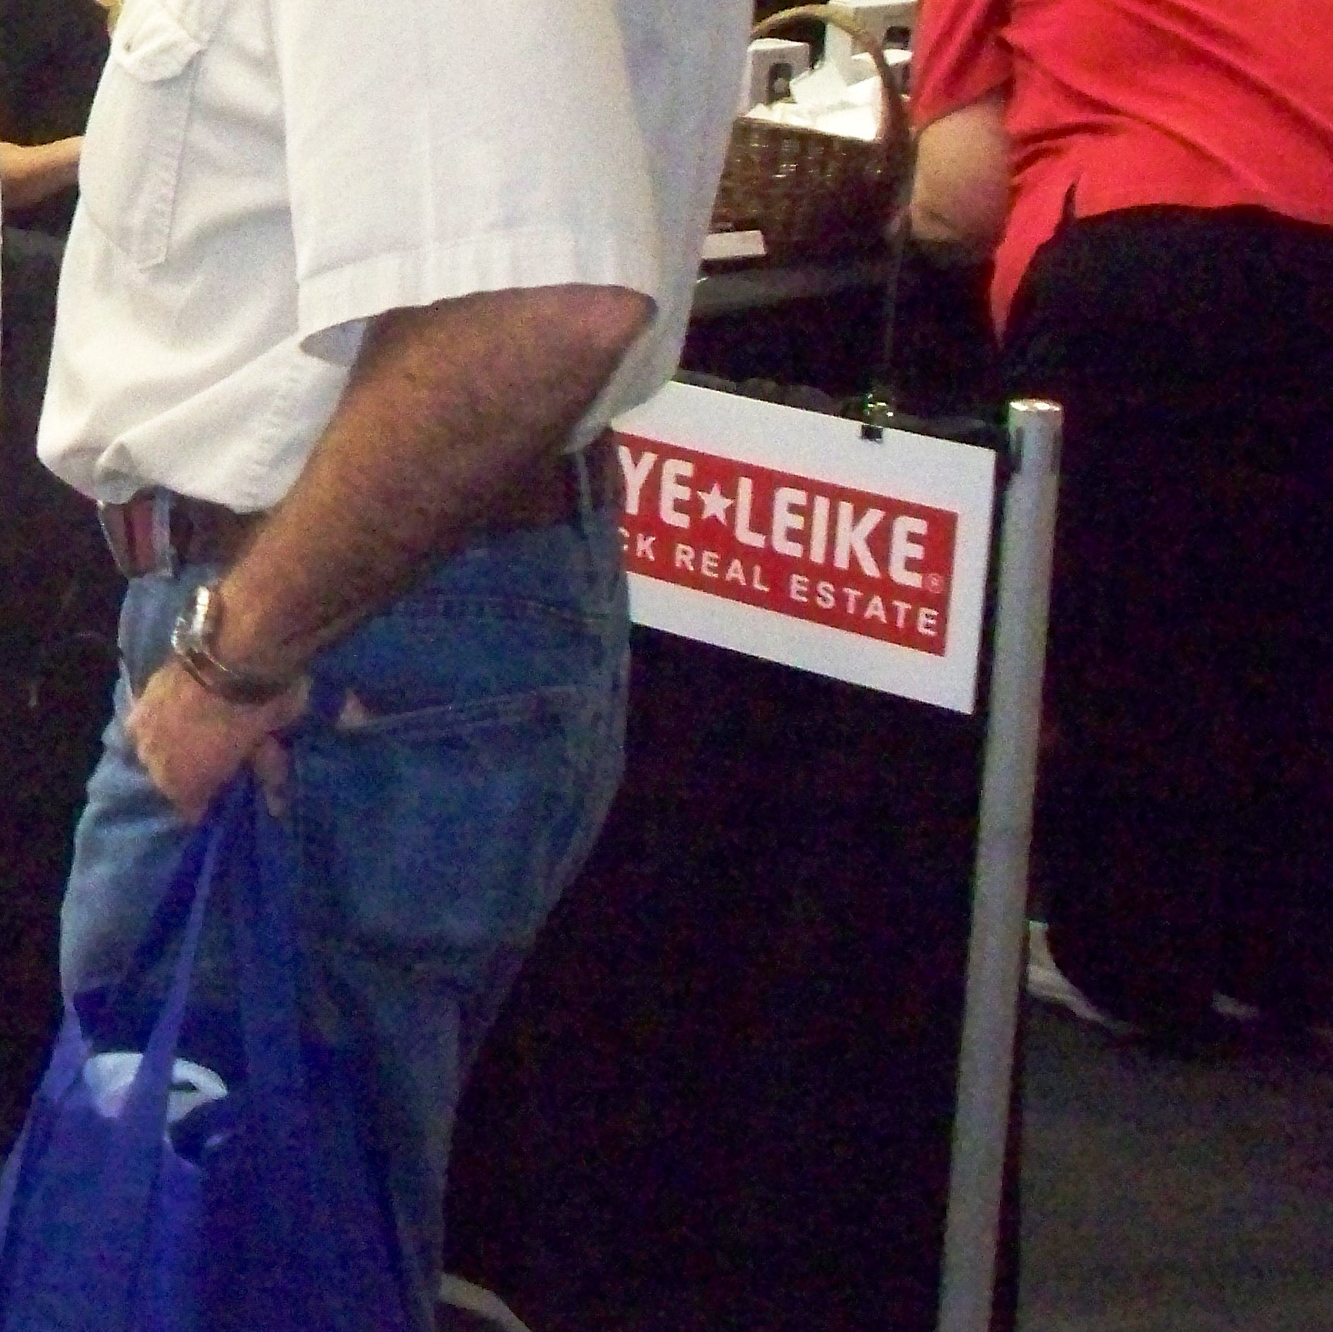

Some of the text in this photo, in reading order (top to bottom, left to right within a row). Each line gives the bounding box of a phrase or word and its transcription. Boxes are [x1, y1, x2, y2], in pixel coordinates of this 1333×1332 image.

[734, 476, 929, 589] LEIKE
[674, 542, 770, 593] REAL
[788, 574, 939, 637] ESTATE
